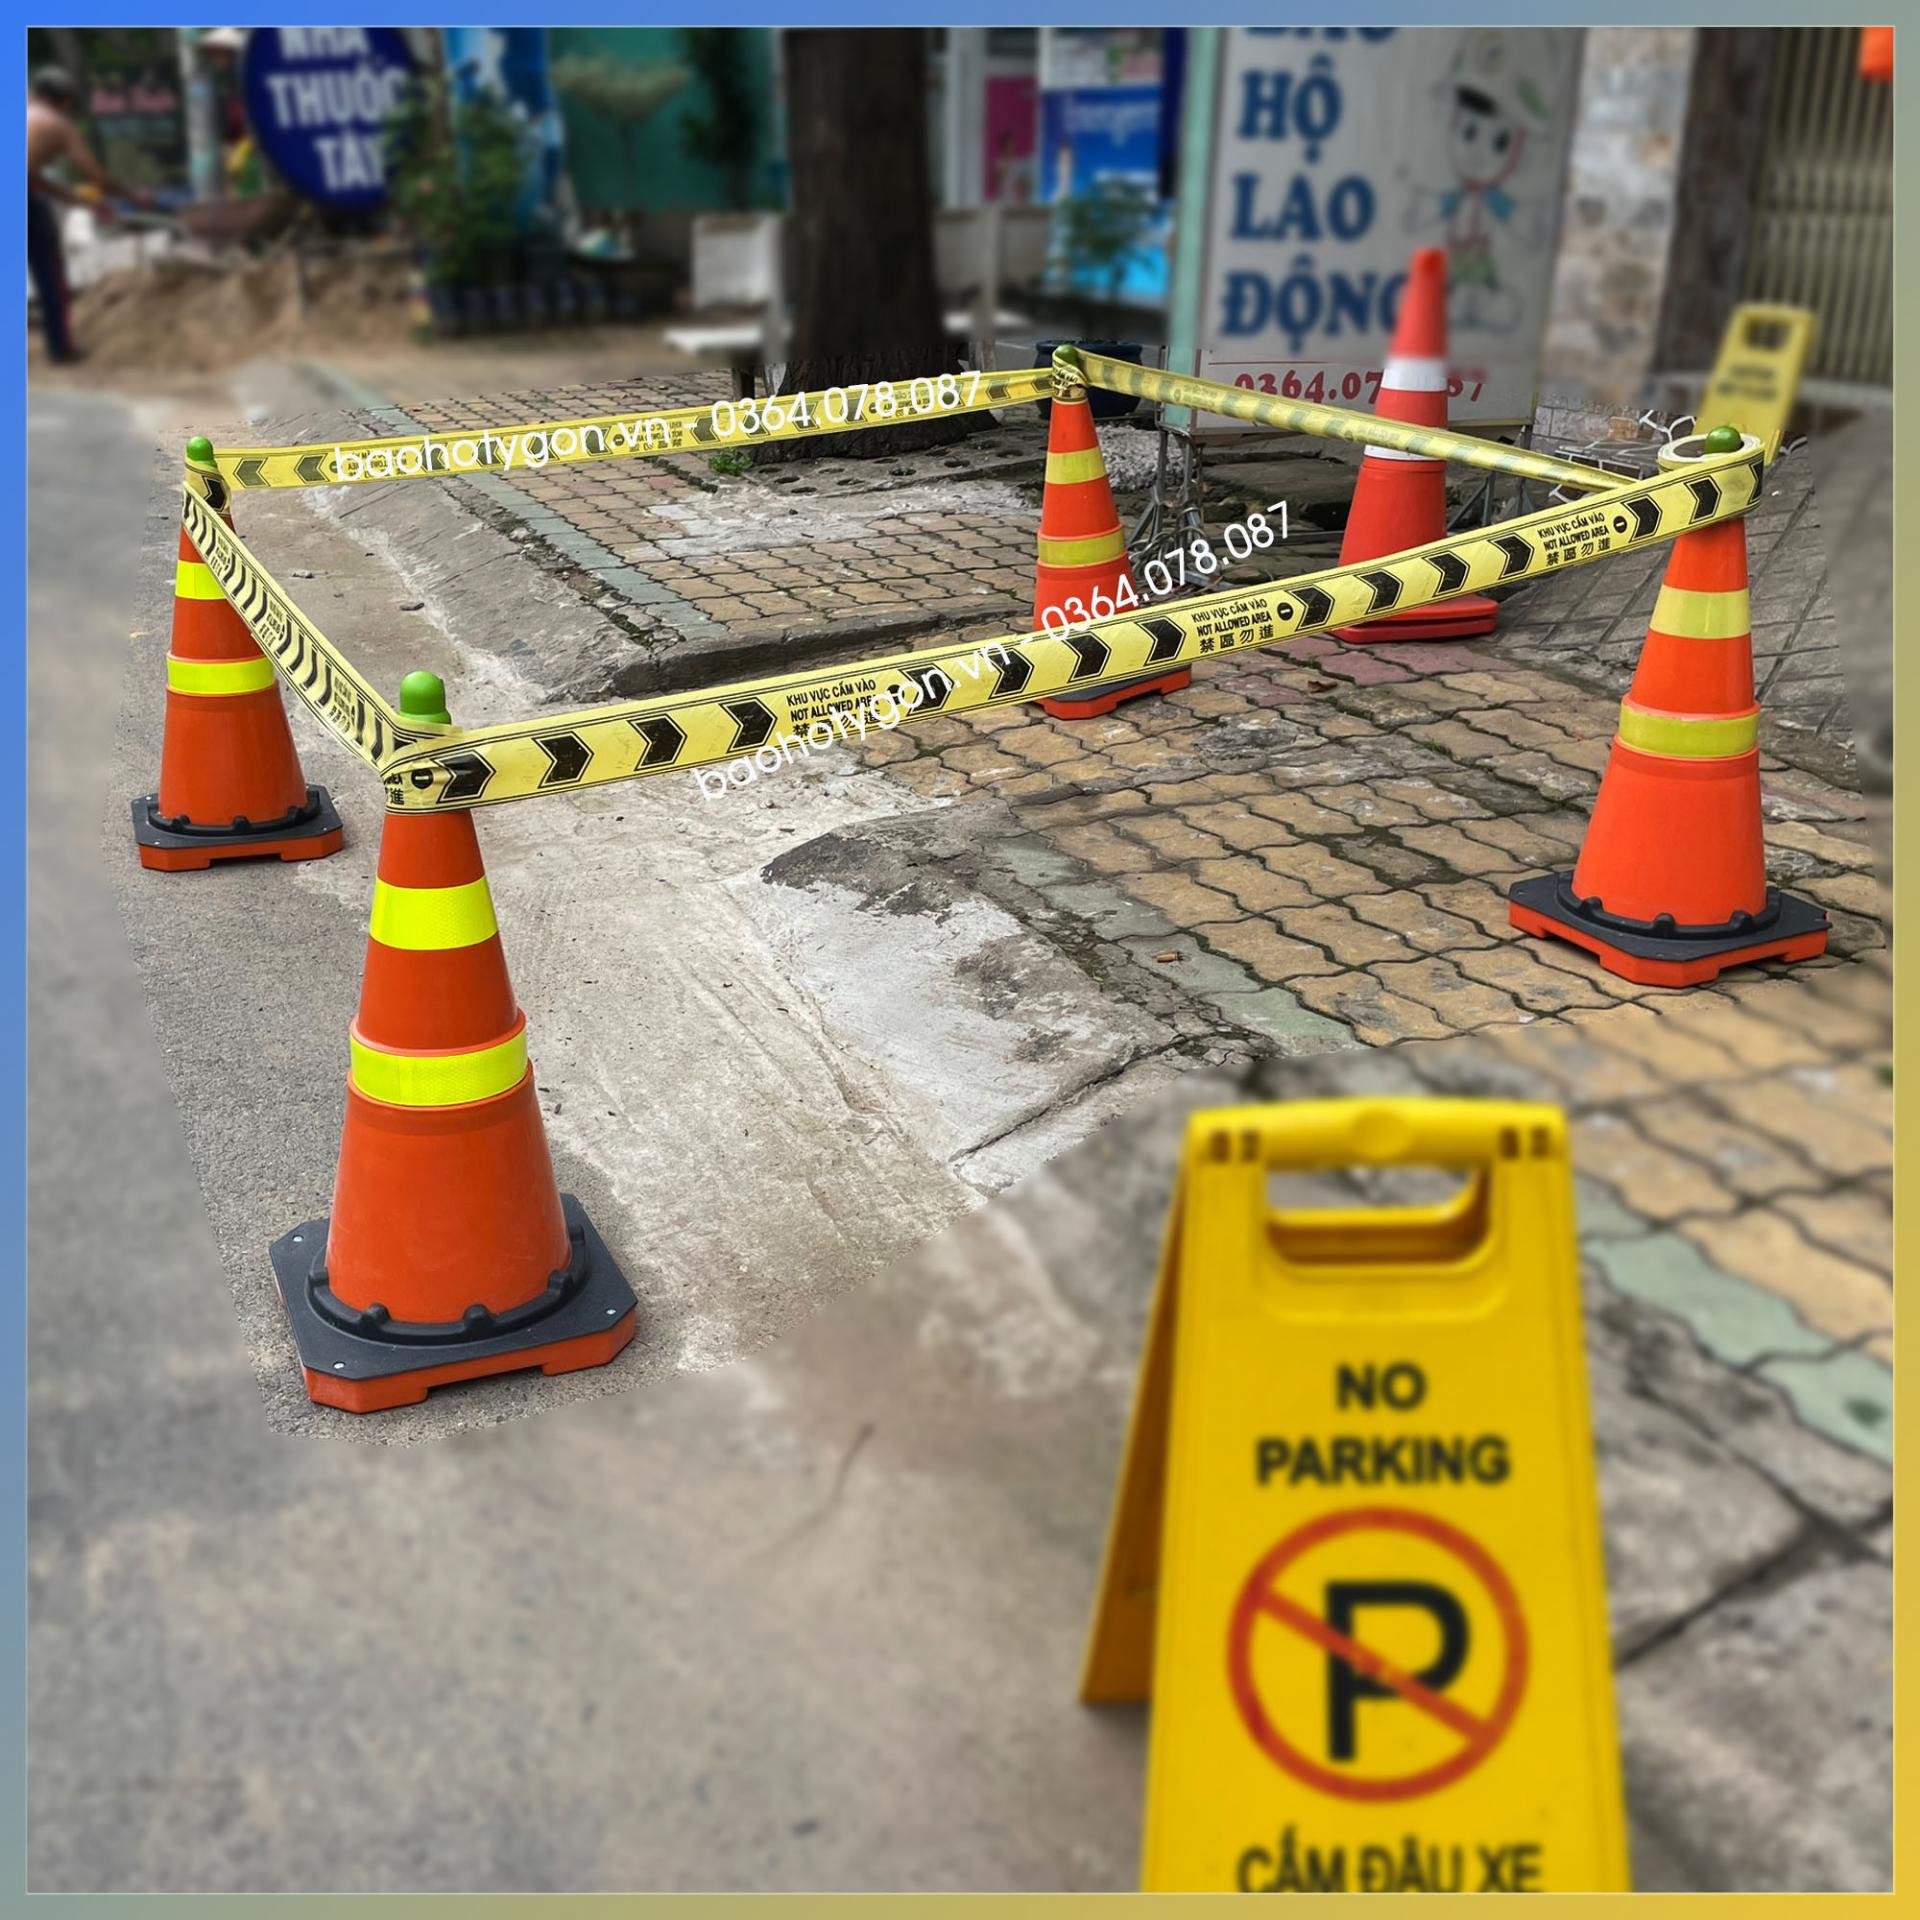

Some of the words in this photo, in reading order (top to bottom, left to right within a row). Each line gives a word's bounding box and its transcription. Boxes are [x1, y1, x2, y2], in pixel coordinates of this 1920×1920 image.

[1237, 53, 1343, 165] HỘ
[1230, 172, 1377, 243] LAO
[1536, 527, 1555, 539] KHU
[1543, 539, 1558, 551] NOT
[1559, 530, 1590, 546] ALLOWED
[1591, 525, 1609, 538] AREA
[1191, 611, 1211, 623] KHU
[1248, 598, 1268, 610] VÀO
[1196, 624, 1213, 637] NOT
[1214, 615, 1250, 633] ALLOWED
[1251, 611, 1272, 625] AREA
[786, 692, 808, 707] KHU
[809, 687, 831, 703] VỰC
[832, 680, 854, 697] CẤM
[855, 678, 876, 692] VÀO
[790, 708, 809, 722] NOT
[1336, 1361, 1428, 1411] NO
[1255, 1434, 1512, 1487] PARKING
[1476, 1843, 1543, 1892] XE
